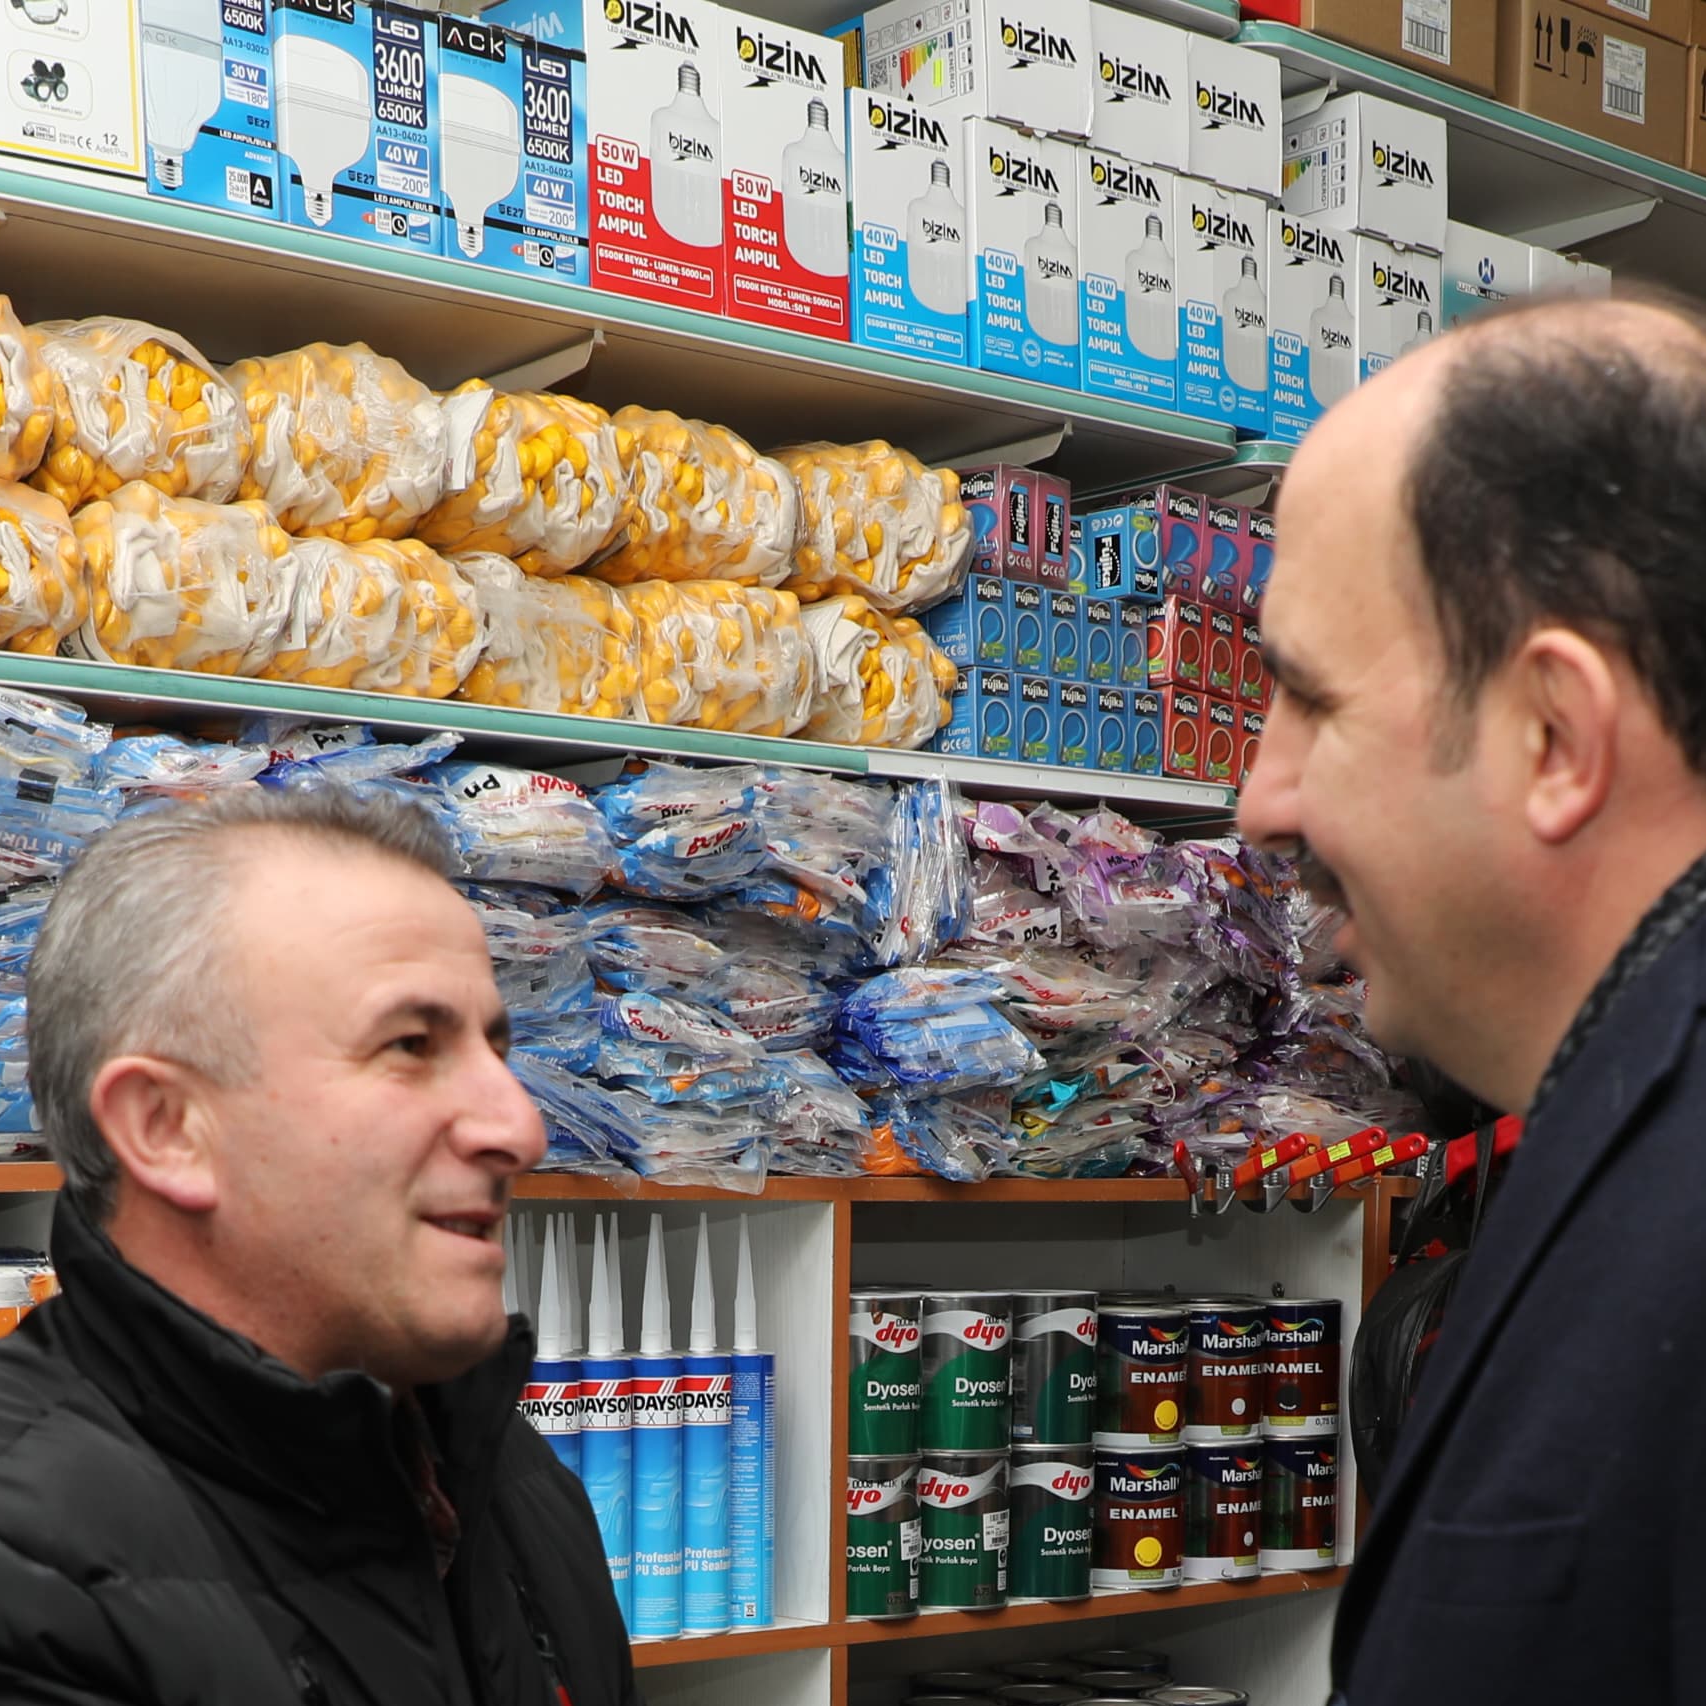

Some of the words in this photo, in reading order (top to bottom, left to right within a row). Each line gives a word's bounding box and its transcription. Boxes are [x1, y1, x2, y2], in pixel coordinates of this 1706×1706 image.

[223, 9, 264, 33] 6500K
[376, 16, 420, 41] LED
[375, 43, 424, 88] 3600
[526, 55, 566, 78] LED
[378, 82, 422, 101] LUMEN
[524, 81, 570, 125] 3600
[378, 103, 424, 127] 6500K
[376, 125, 428, 144] AA13-04023
[526, 118, 568, 137] LUMEN
[527, 139, 570, 162] 6500K
[597, 166, 623, 186] LED
[597, 189, 644, 215] TORCH
[733, 201, 758, 219] LED
[598, 213, 647, 239] AMPUL
[733, 222, 777, 246] TORCH
[735, 246, 781, 270] AMPUL
[863, 248, 884, 264] LED
[863, 268, 902, 289] TORCH
[864, 290, 905, 310] AMPUL
[875, 1319, 920, 1348] dyo
[963, 1319, 1006, 1345] dyo
[1052, 1471, 1090, 1496] dyo
[1109, 1508, 1178, 1520] ENAMEL
